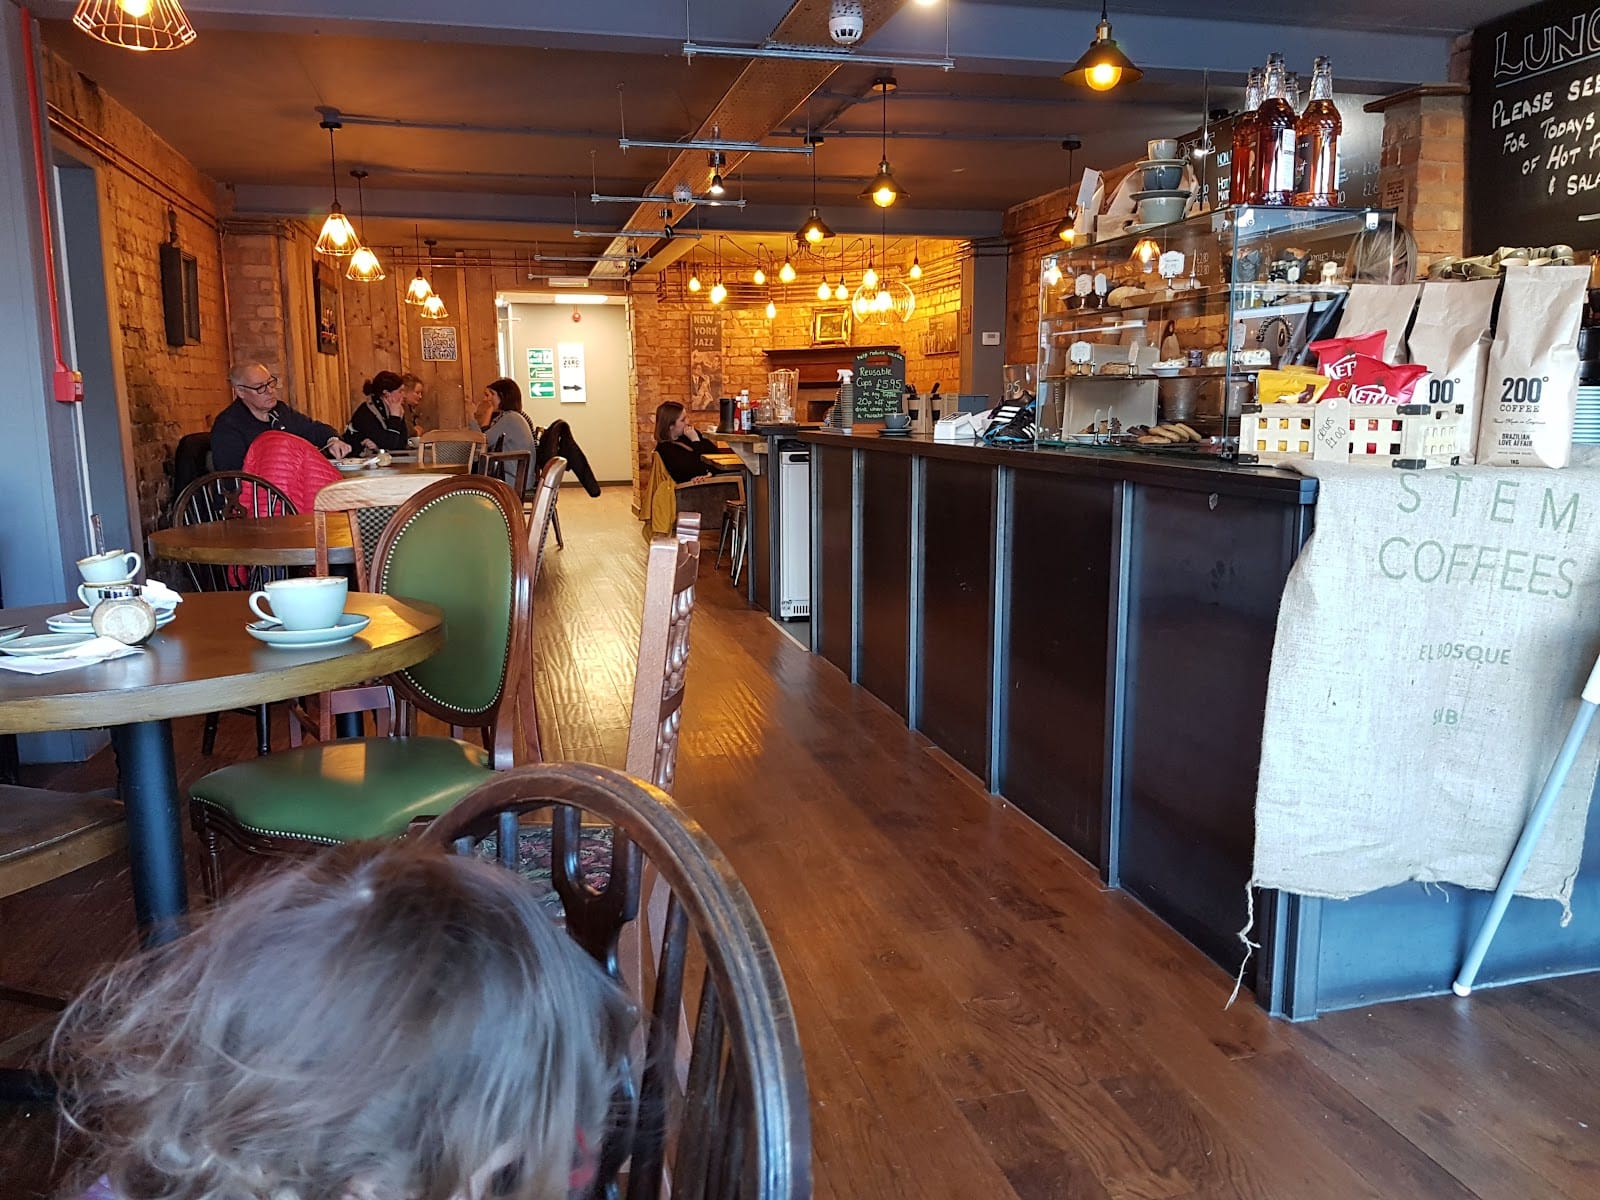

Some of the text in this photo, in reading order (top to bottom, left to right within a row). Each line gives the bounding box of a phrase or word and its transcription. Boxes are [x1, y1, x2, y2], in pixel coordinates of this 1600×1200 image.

[1492, 91, 1554, 129] PLEASE
[1502, 112, 1596, 155] FOR TODAYS
[1521, 154, 1541, 175] OF
[1546, 144, 1582, 170] HOT
[693, 315, 714, 325] NEW
[694, 326, 718, 336] YORK
[694, 338, 714, 347] JAZZ
[859, 366, 892, 376] Reusable
[856, 377, 872, 389] Cups
[1499, 404, 1541, 413] COFFEE
[1498, 439, 1512, 447] LOVE
[1378, 536, 1578, 600] COFFEES
